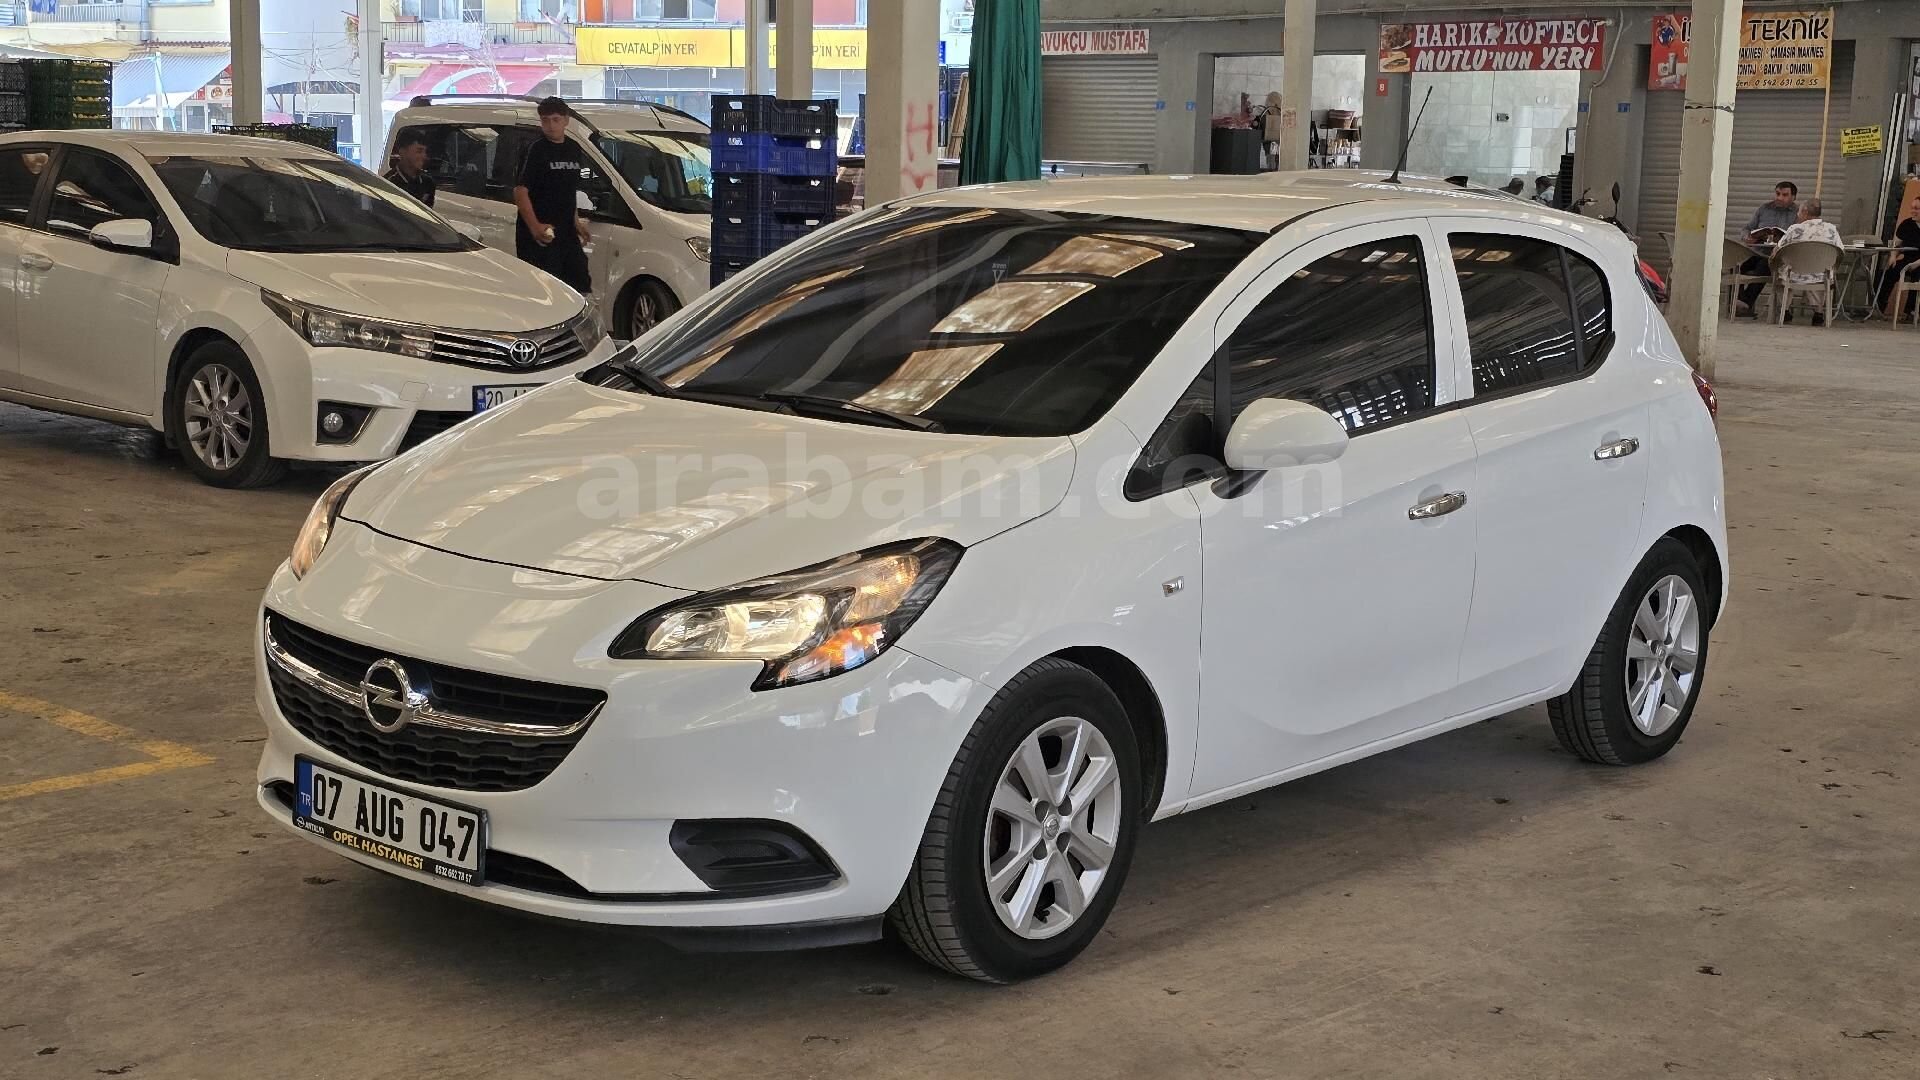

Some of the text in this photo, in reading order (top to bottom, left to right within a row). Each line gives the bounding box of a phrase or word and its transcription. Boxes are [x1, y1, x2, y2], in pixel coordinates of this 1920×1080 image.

[1748, 15, 1830, 41] TEKNİK
[835, 42, 860, 58] YERİ
[1091, 30, 1147, 51] MUSTAFA
[1414, 46, 1596, 72] MUTLU'NUN YERİ
[1789, 63, 1813, 75] ONARIM
[1762, 79, 1777, 87] 542
[1780, 79, 1793, 87] 631
[1795, 79, 1805, 87] 02
[1808, 79, 1819, 87] 55
[300, 791, 311, 807] TR
[312, 773, 476, 863] 07 AUG 047
[333, 830, 361, 850] OPEL
